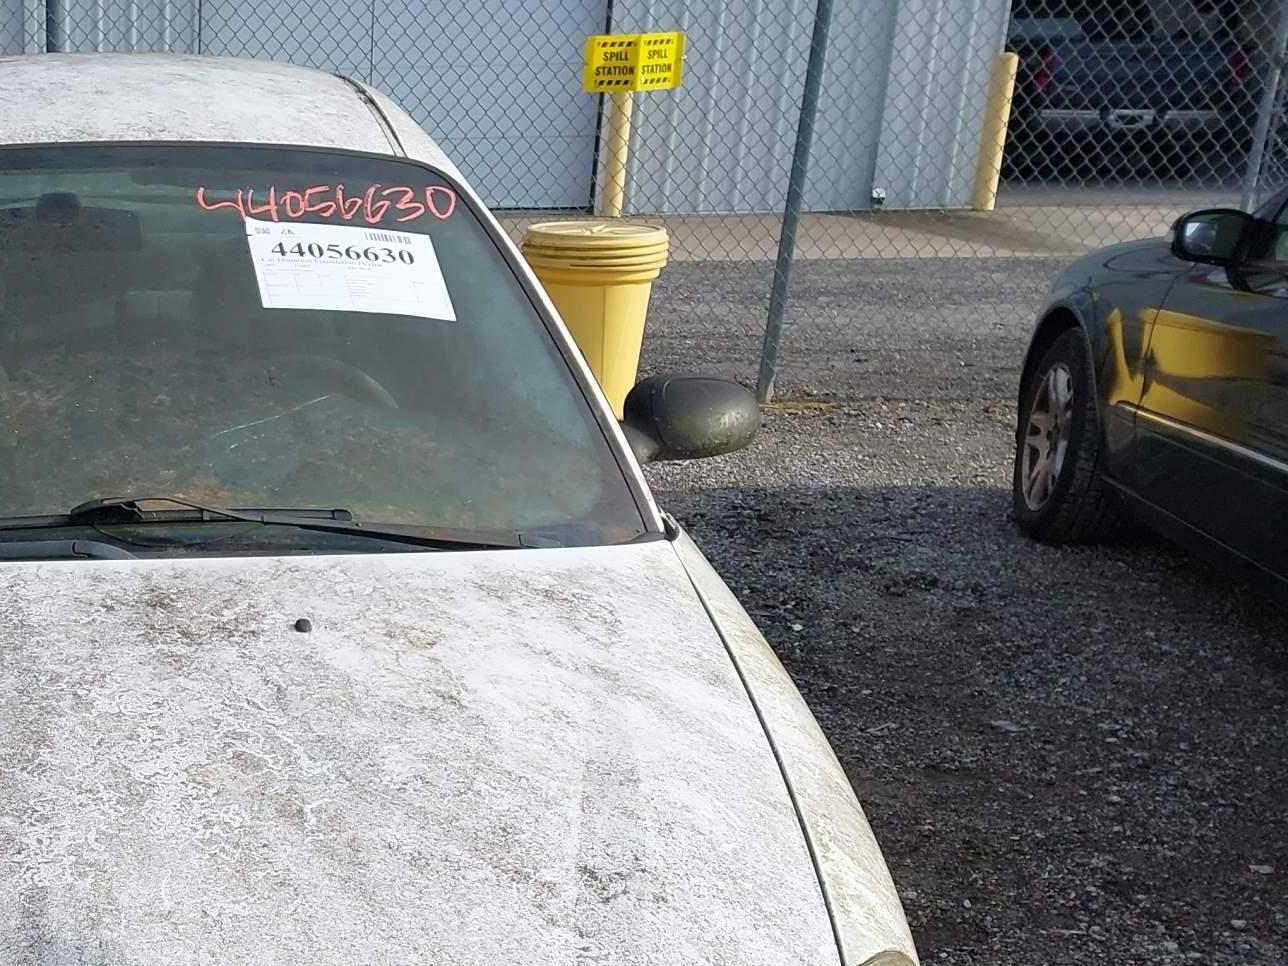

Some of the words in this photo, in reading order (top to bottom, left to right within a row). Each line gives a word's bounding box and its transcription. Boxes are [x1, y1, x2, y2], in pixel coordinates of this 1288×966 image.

[603, 51, 630, 61] SPILL
[648, 48, 667, 60] SPILL
[595, 65, 635, 77] STATION
[641, 63, 672, 75] STATION
[197, 183, 457, 223] 44056630
[271, 241, 415, 265] 44056630
